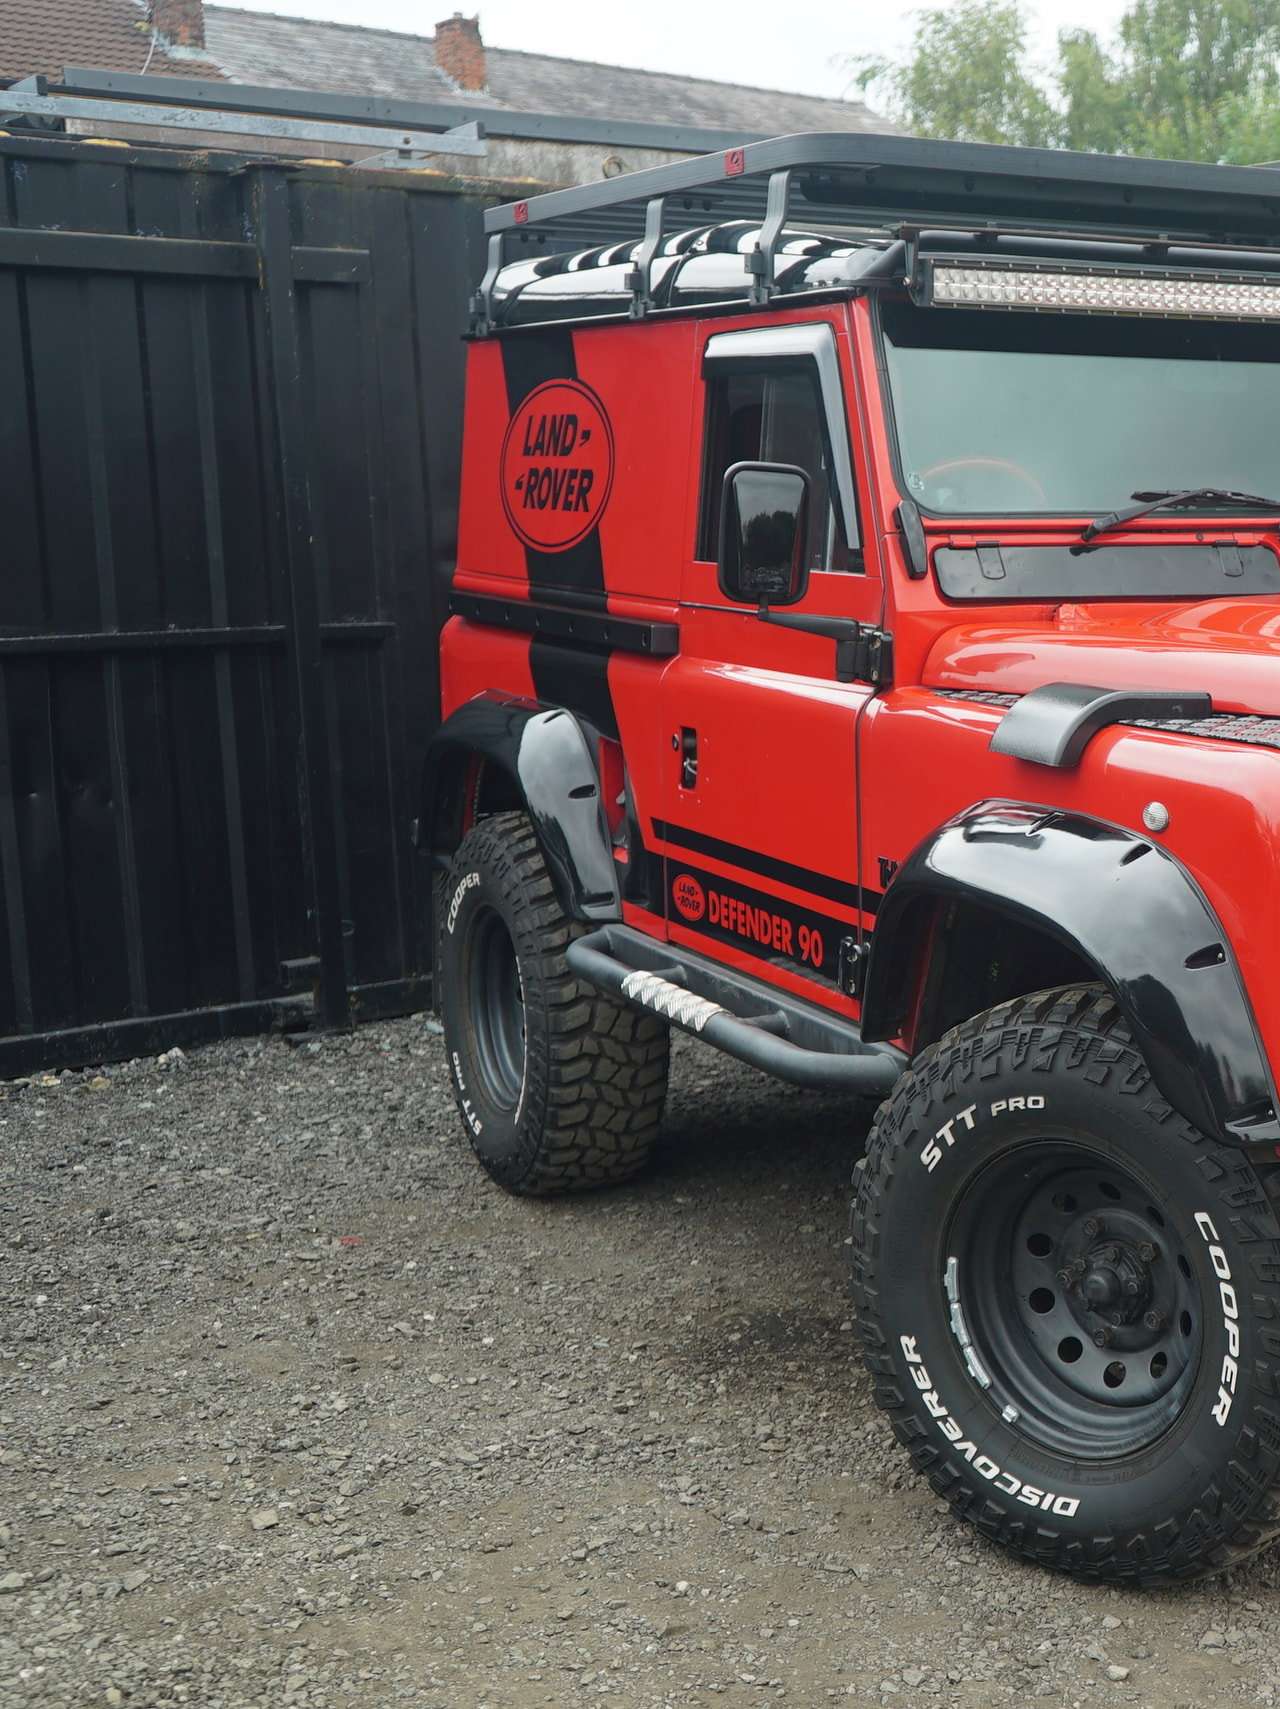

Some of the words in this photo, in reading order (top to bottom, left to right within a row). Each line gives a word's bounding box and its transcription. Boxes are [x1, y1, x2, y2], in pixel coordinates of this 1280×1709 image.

[522, 414, 578, 457] LAND
[522, 466, 594, 513] ROVER
[447, 872, 481, 935] COOPER
[707, 889, 794, 957] DEFENDER
[798, 924, 824, 969] 90
[919, 1104, 978, 1174] STT
[990, 1095, 1046, 1118] PRO
[1193, 1211, 1241, 1427] COOPER
[899, 1333, 1081, 1519] DISCOVERER
